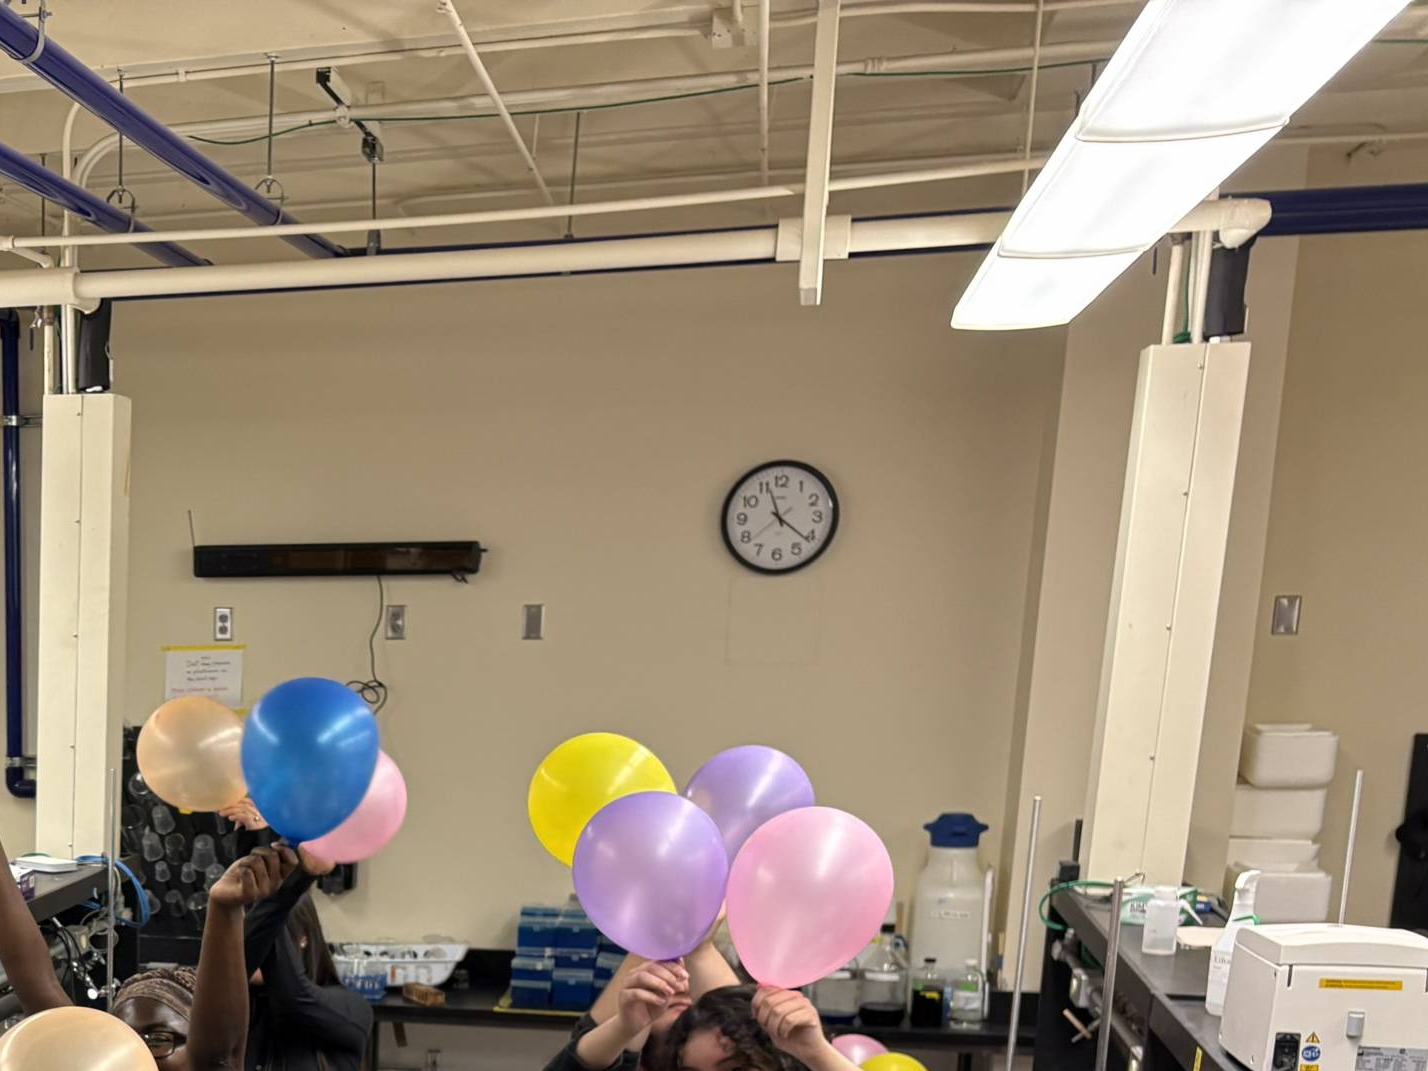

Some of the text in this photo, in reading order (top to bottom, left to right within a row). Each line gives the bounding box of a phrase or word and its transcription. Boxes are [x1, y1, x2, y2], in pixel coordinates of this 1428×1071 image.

[759, 481, 770, 494] 11
[774, 474, 789, 488] 12
[798, 480, 805, 493] 1
[743, 495, 759, 508] 10
[808, 493, 819, 507] 2
[736, 512, 748, 526] 9
[812, 510, 823, 523] 3
[740, 530, 751, 544] 8
[754, 543, 764, 557] 7
[771, 548, 782, 561] 6
[790, 542, 802, 556] 5
